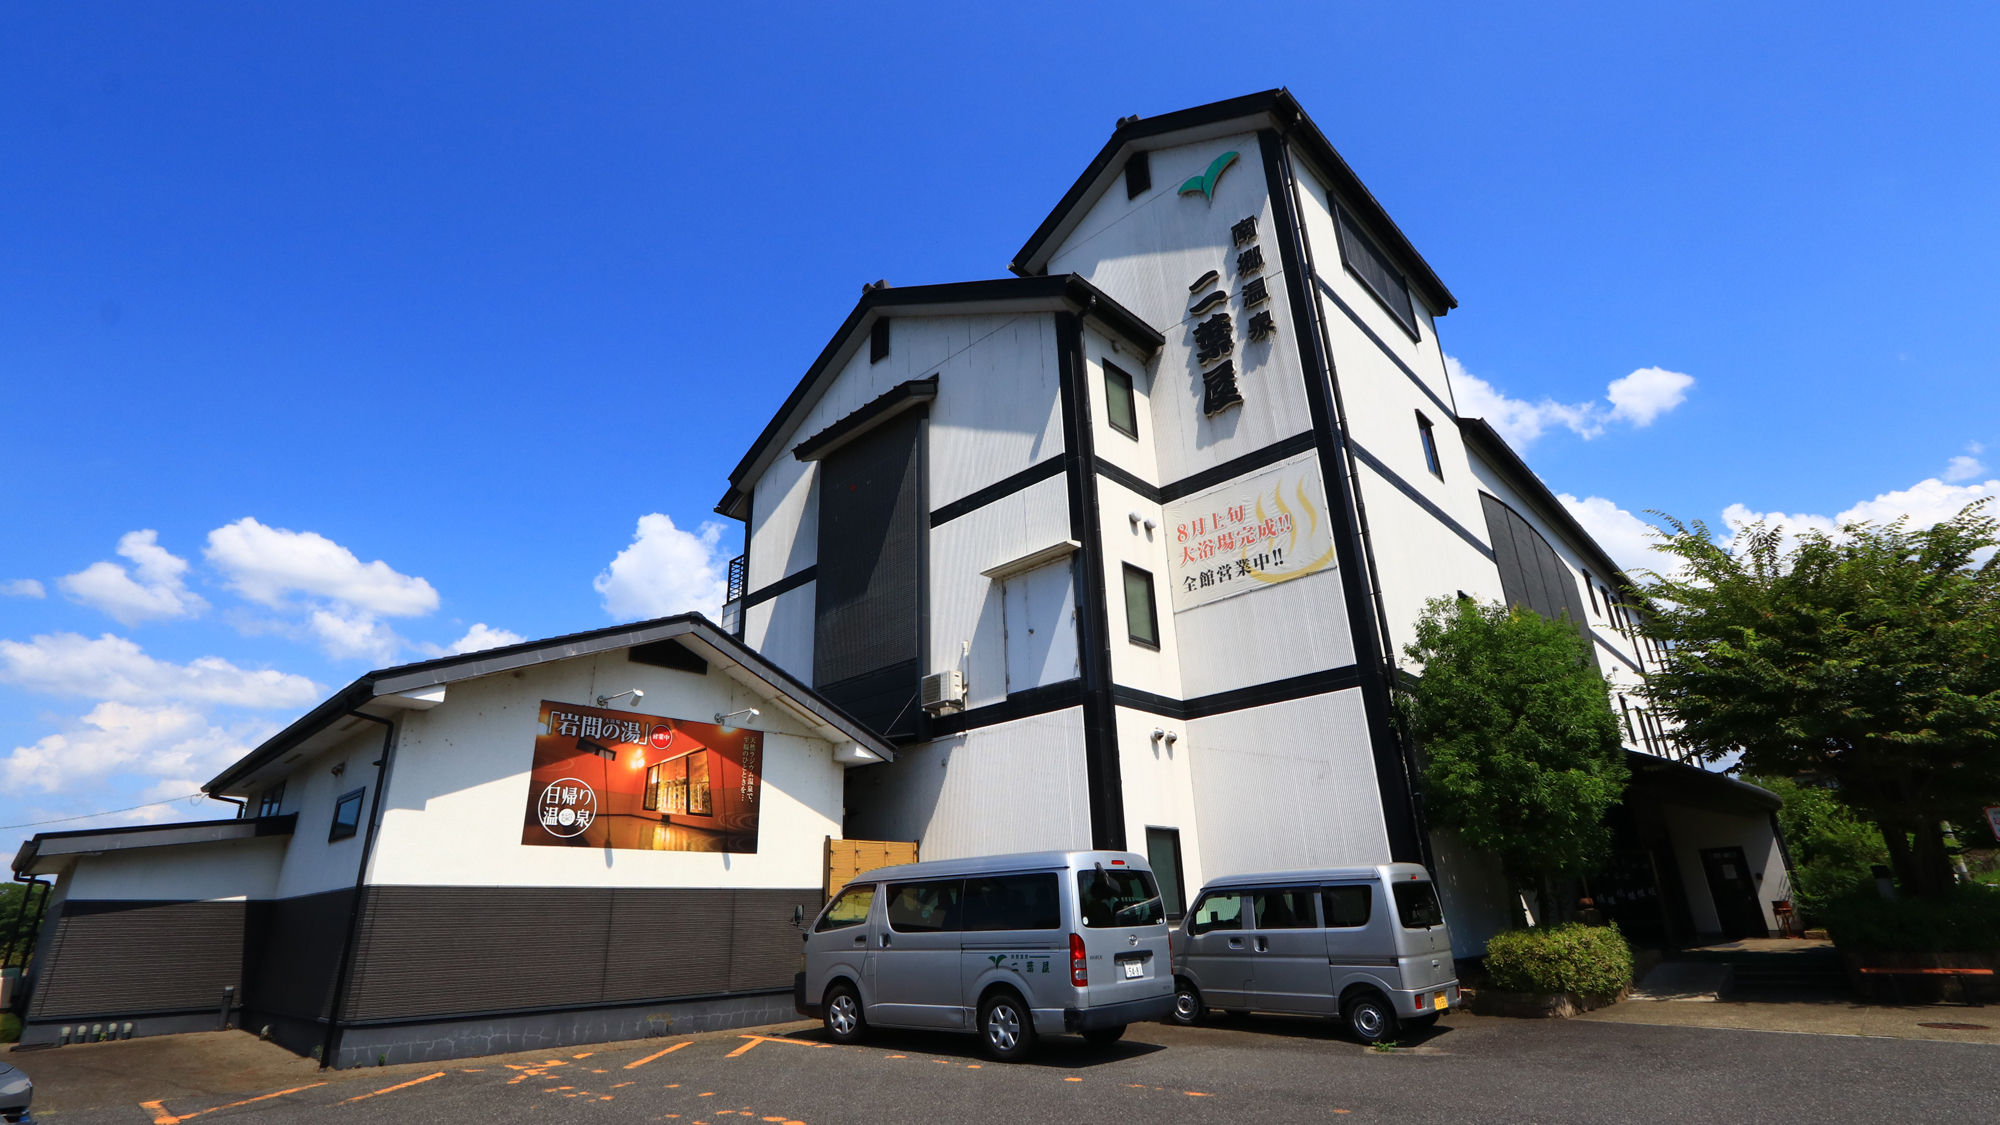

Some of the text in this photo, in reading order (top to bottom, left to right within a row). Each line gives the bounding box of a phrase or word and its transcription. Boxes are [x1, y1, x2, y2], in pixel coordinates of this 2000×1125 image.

[1189, 270, 1244, 417] 二葉屋
[1177, 505, 1246, 542] 8月上旬
[1180, 514, 1293, 567] 大浴場完成!!
[1183, 548, 1284, 593] 全館営業中!!
[546, 786, 592, 806] 日帰り
[1011, 961, 1050, 973] 二葉屋
